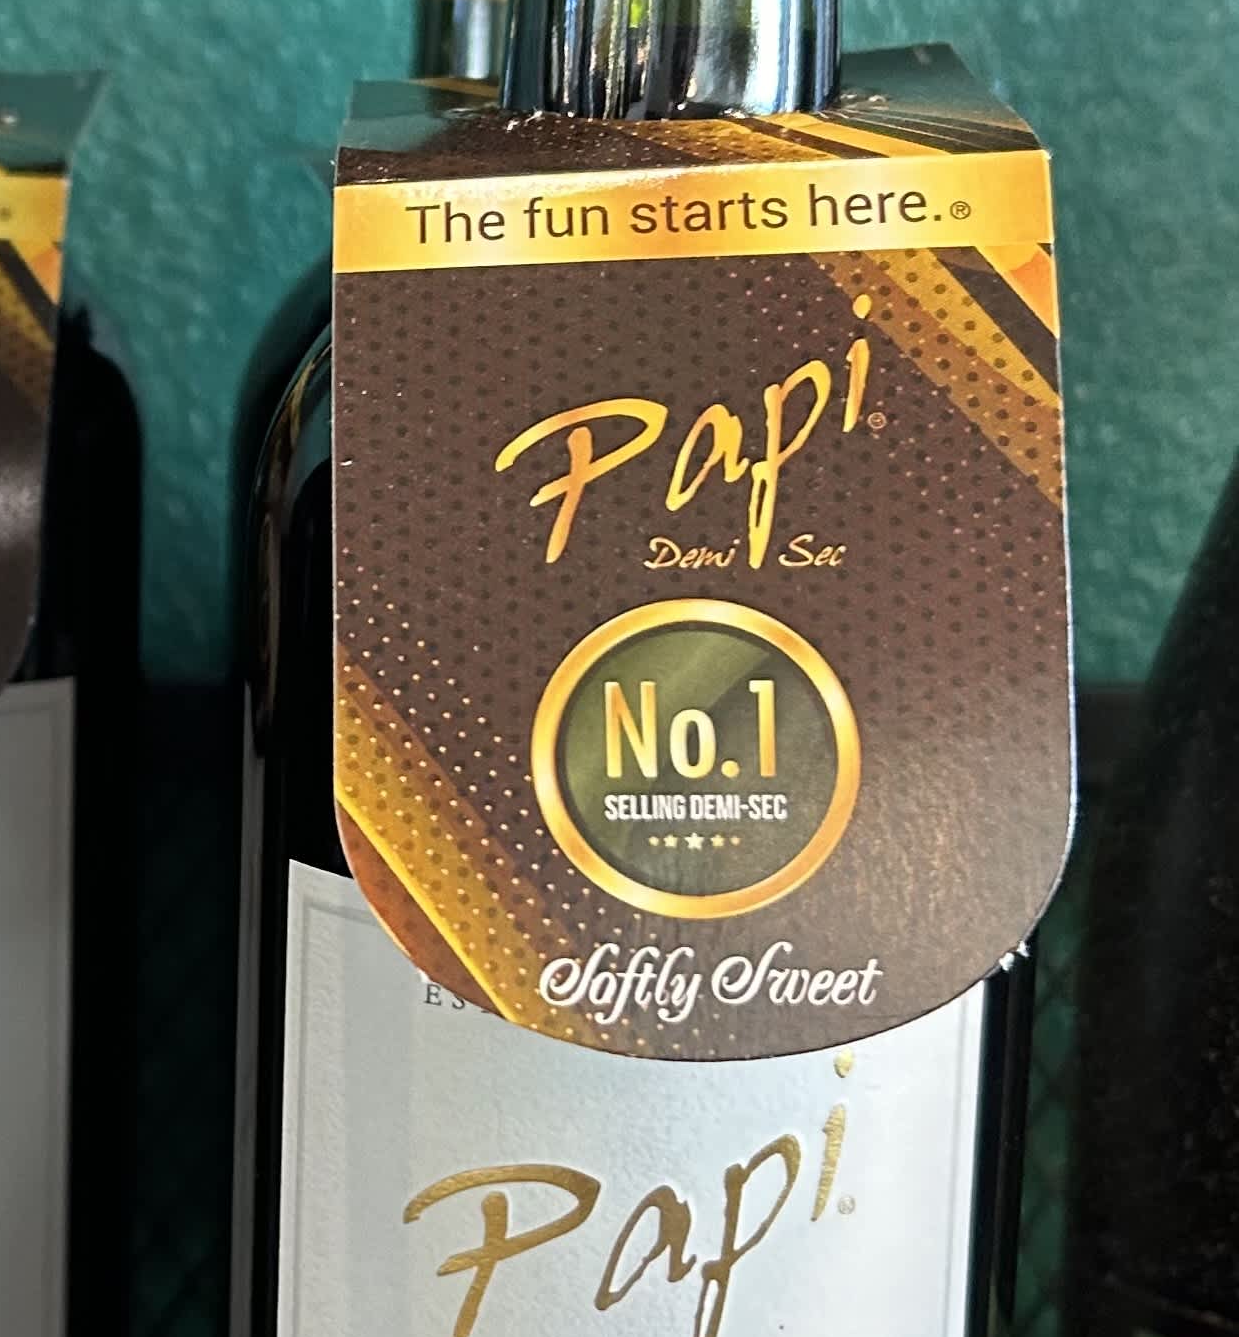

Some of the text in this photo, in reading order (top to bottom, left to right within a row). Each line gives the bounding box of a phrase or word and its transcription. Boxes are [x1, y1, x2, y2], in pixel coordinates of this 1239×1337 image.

[406, 203, 506, 245] The
[523, 197, 610, 239] fun
[629, 196, 788, 236] starts
[644, 533, 847, 569] Demi Sec
[604, 679, 778, 779] No.1
[604, 794, 788, 822] SELLING DEMI-SEC
[538, 941, 884, 1025] Softly Sweet
